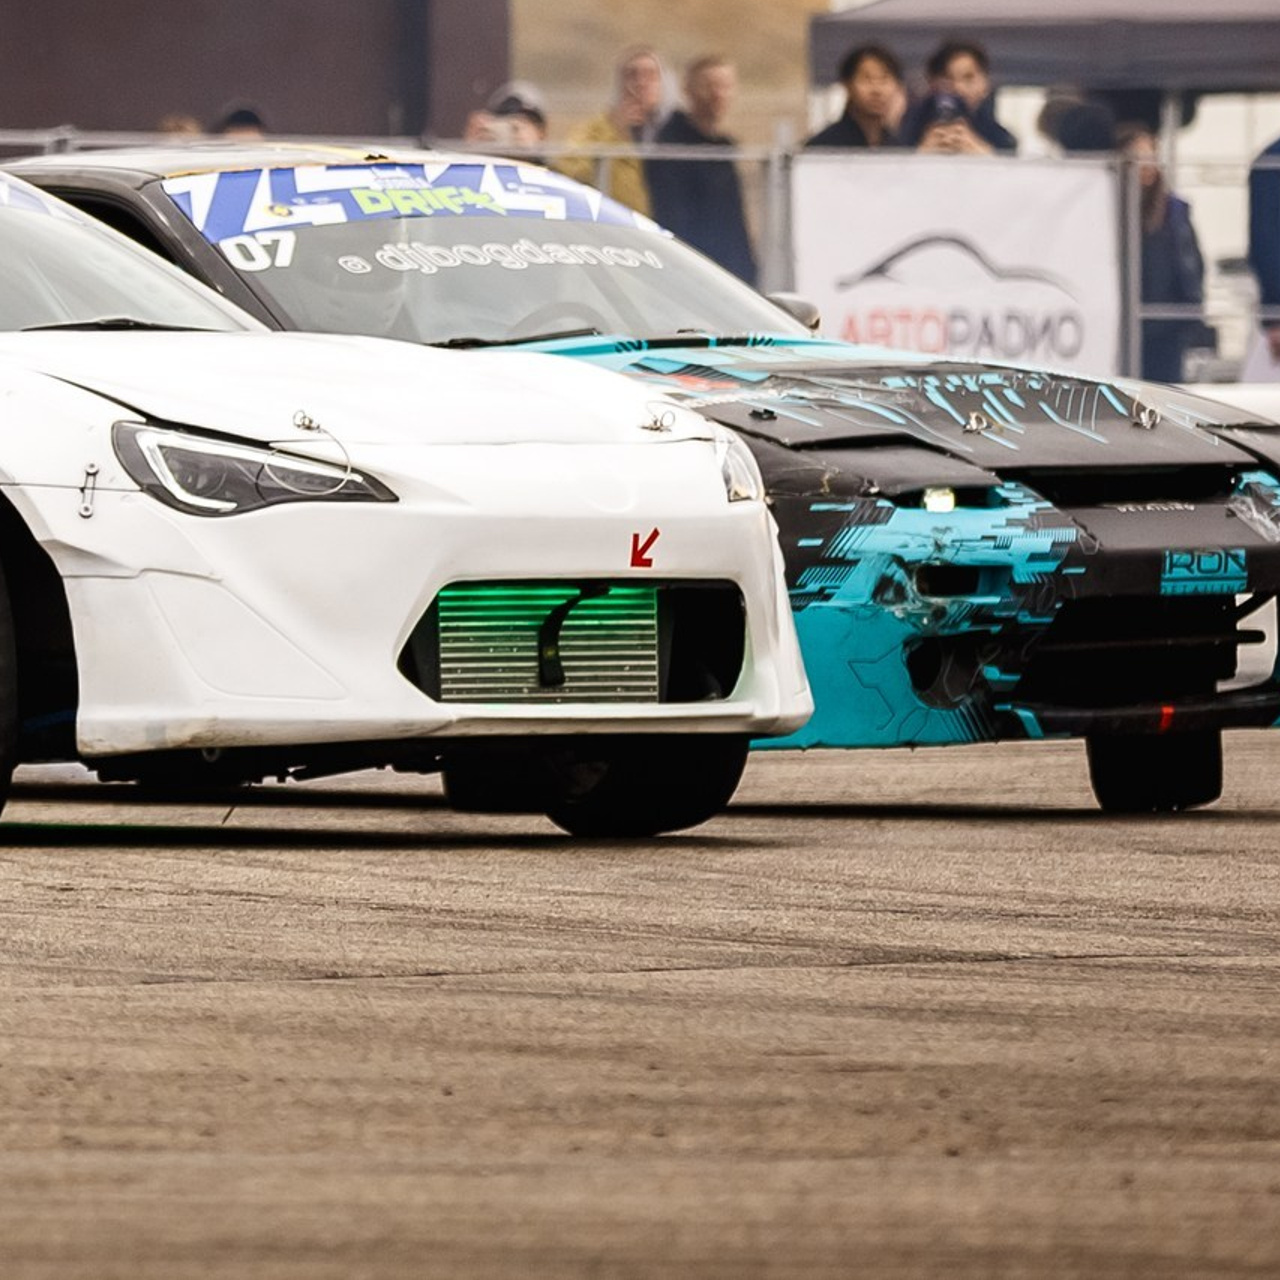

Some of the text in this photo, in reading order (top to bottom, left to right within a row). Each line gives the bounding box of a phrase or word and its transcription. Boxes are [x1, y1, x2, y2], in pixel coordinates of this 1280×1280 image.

[350, 186, 507, 216] DRIFT
[219, 230, 296, 272] 07
[375, 238, 663, 273] djbogdanov
